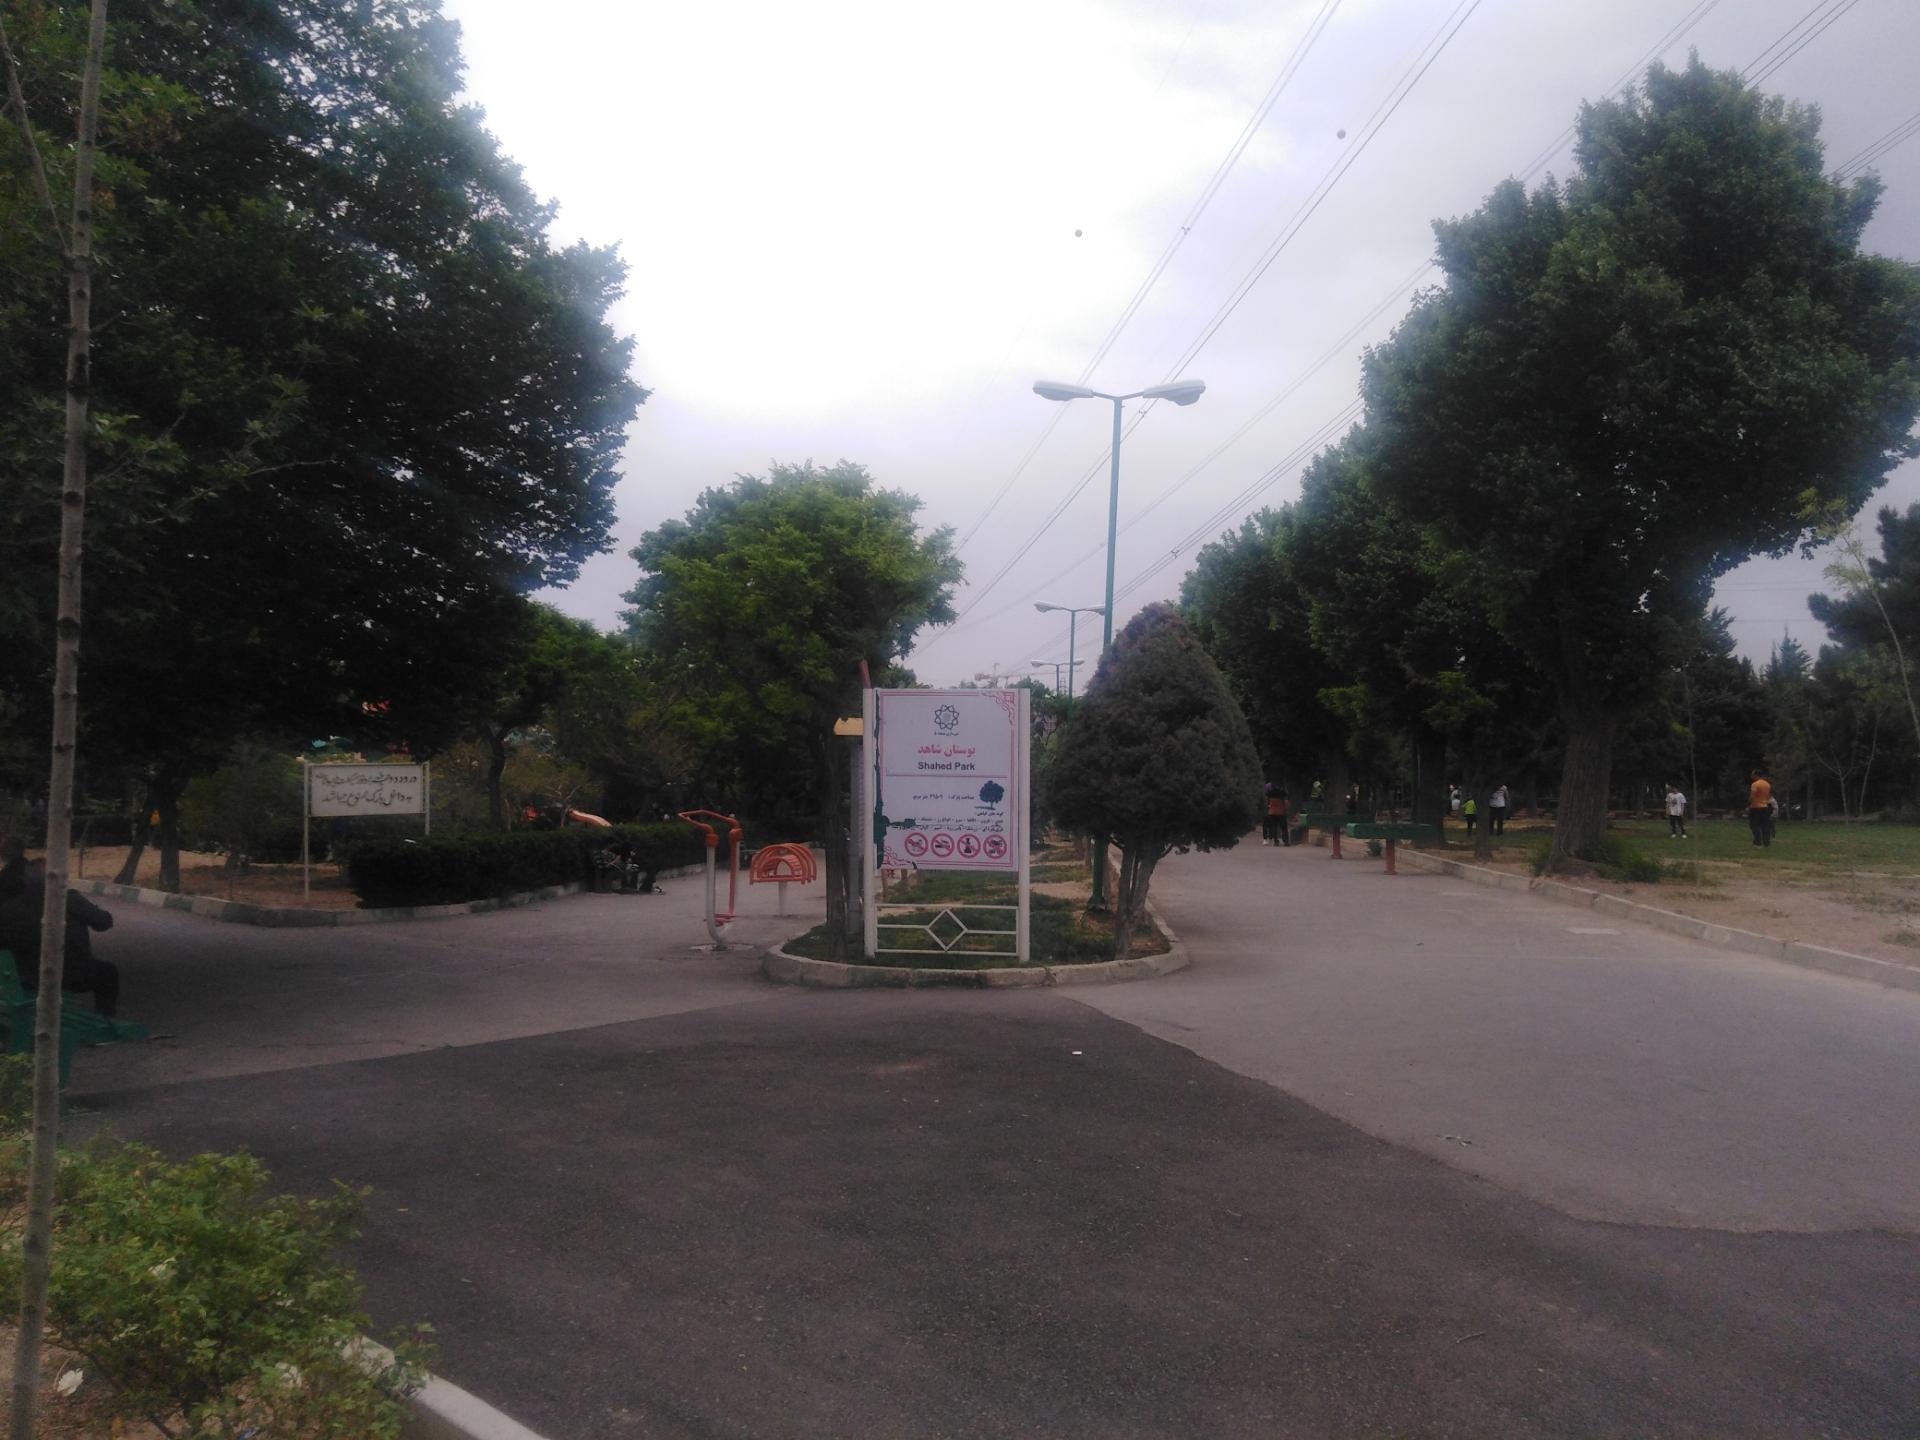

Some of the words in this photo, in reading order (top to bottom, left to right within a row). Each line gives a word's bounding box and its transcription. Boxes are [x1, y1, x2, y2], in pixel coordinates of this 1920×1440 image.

[918, 744, 942, 755] شاهد
[944, 744, 975, 758] بوستان
[918, 761, 952, 771] Shahed
[954, 762, 975, 771] Park
[366, 787, 385, 804] پارک
[383, 789, 405, 807] داخل
